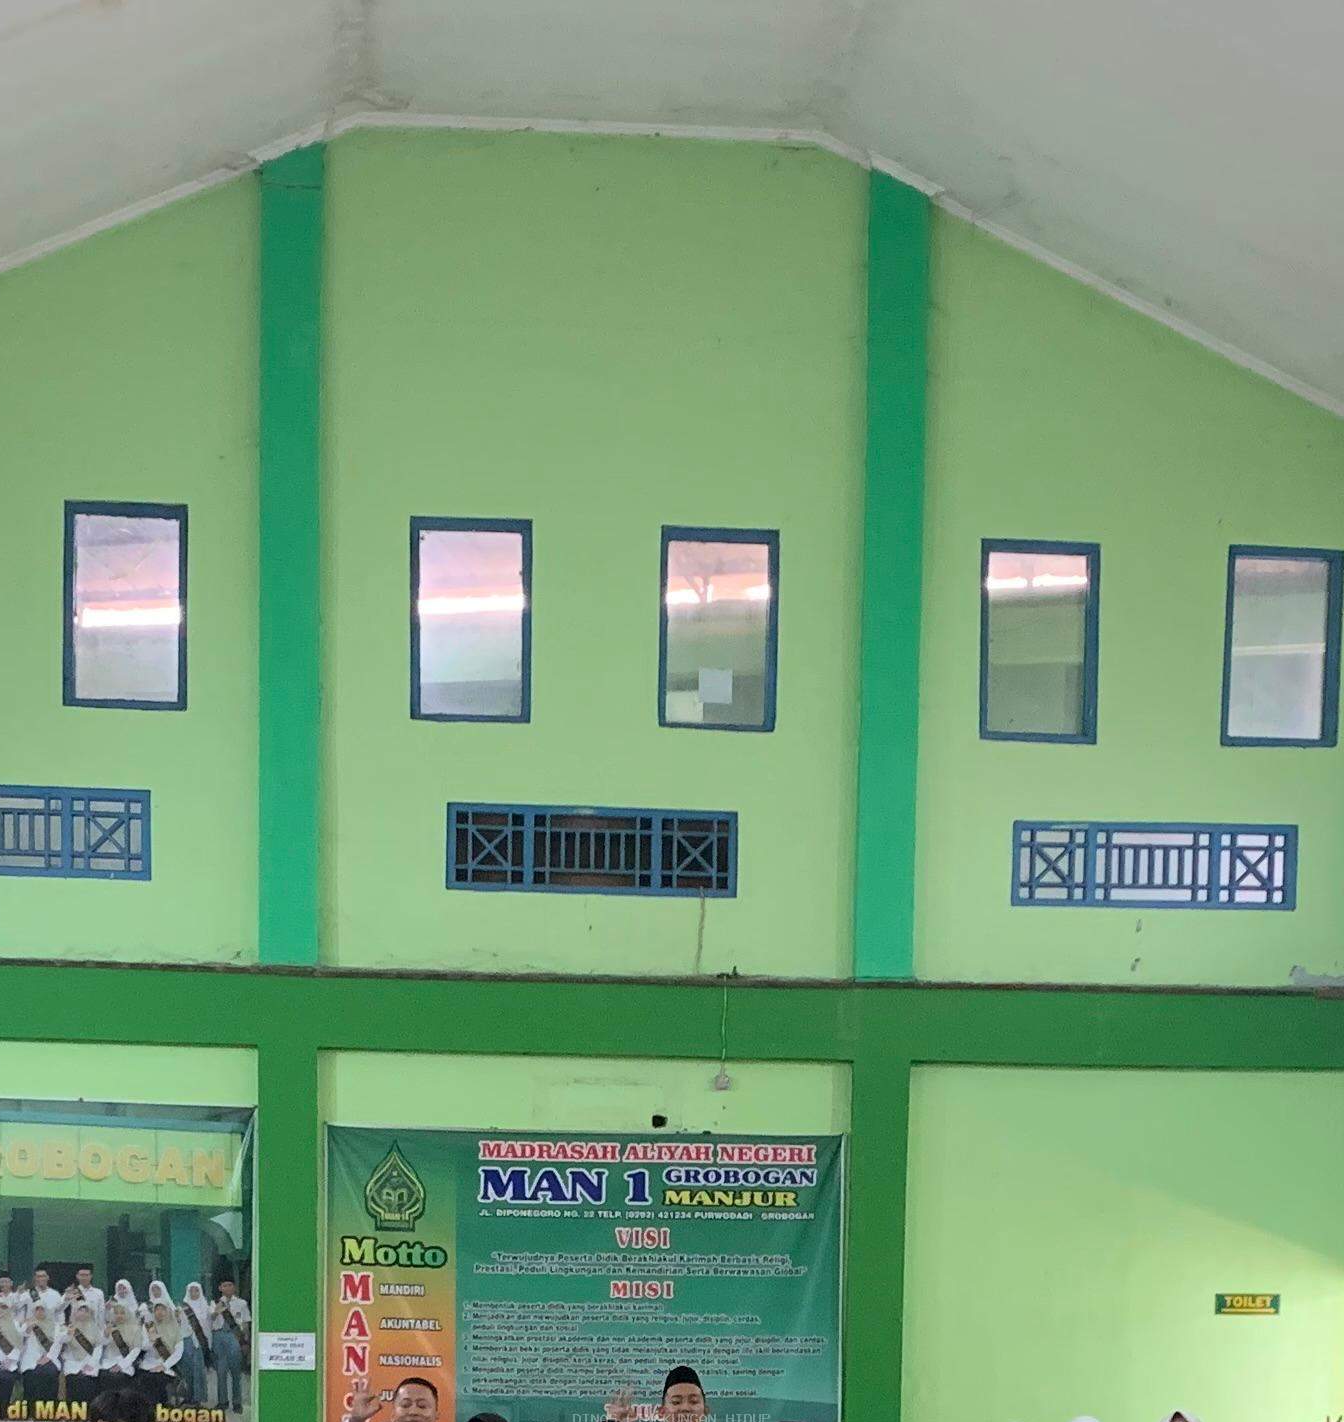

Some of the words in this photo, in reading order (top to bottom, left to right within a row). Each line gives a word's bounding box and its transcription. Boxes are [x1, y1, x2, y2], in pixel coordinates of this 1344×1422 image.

[479, 1141, 620, 1162] MADRASAH
[622, 1142, 713, 1164] ALIYAH
[717, 1144, 817, 1164] NEGERI
[479, 1166, 608, 1204] MAN
[624, 1168, 652, 1206] 1
[663, 1167, 817, 1187] GROBOGAN
[662, 1189, 800, 1208] MANJUR
[615, 1227, 670, 1249] VISI
[340, 1236, 448, 1268] Motto
[341, 1271, 373, 1303] M
[379, 1284, 425, 1296] MANDIRI
[610, 1280, 674, 1299] MISI
[1223, 1295, 1274, 1308] TOILET
[342, 1307, 371, 1340] A
[379, 1318, 443, 1331] AKUNTABEL
[343, 1342, 369, 1375] N
[379, 1354, 443, 1367] NASIONALIS
[7, 1400, 30, 1420] di
[35, 1401, 88, 1421] MAN
